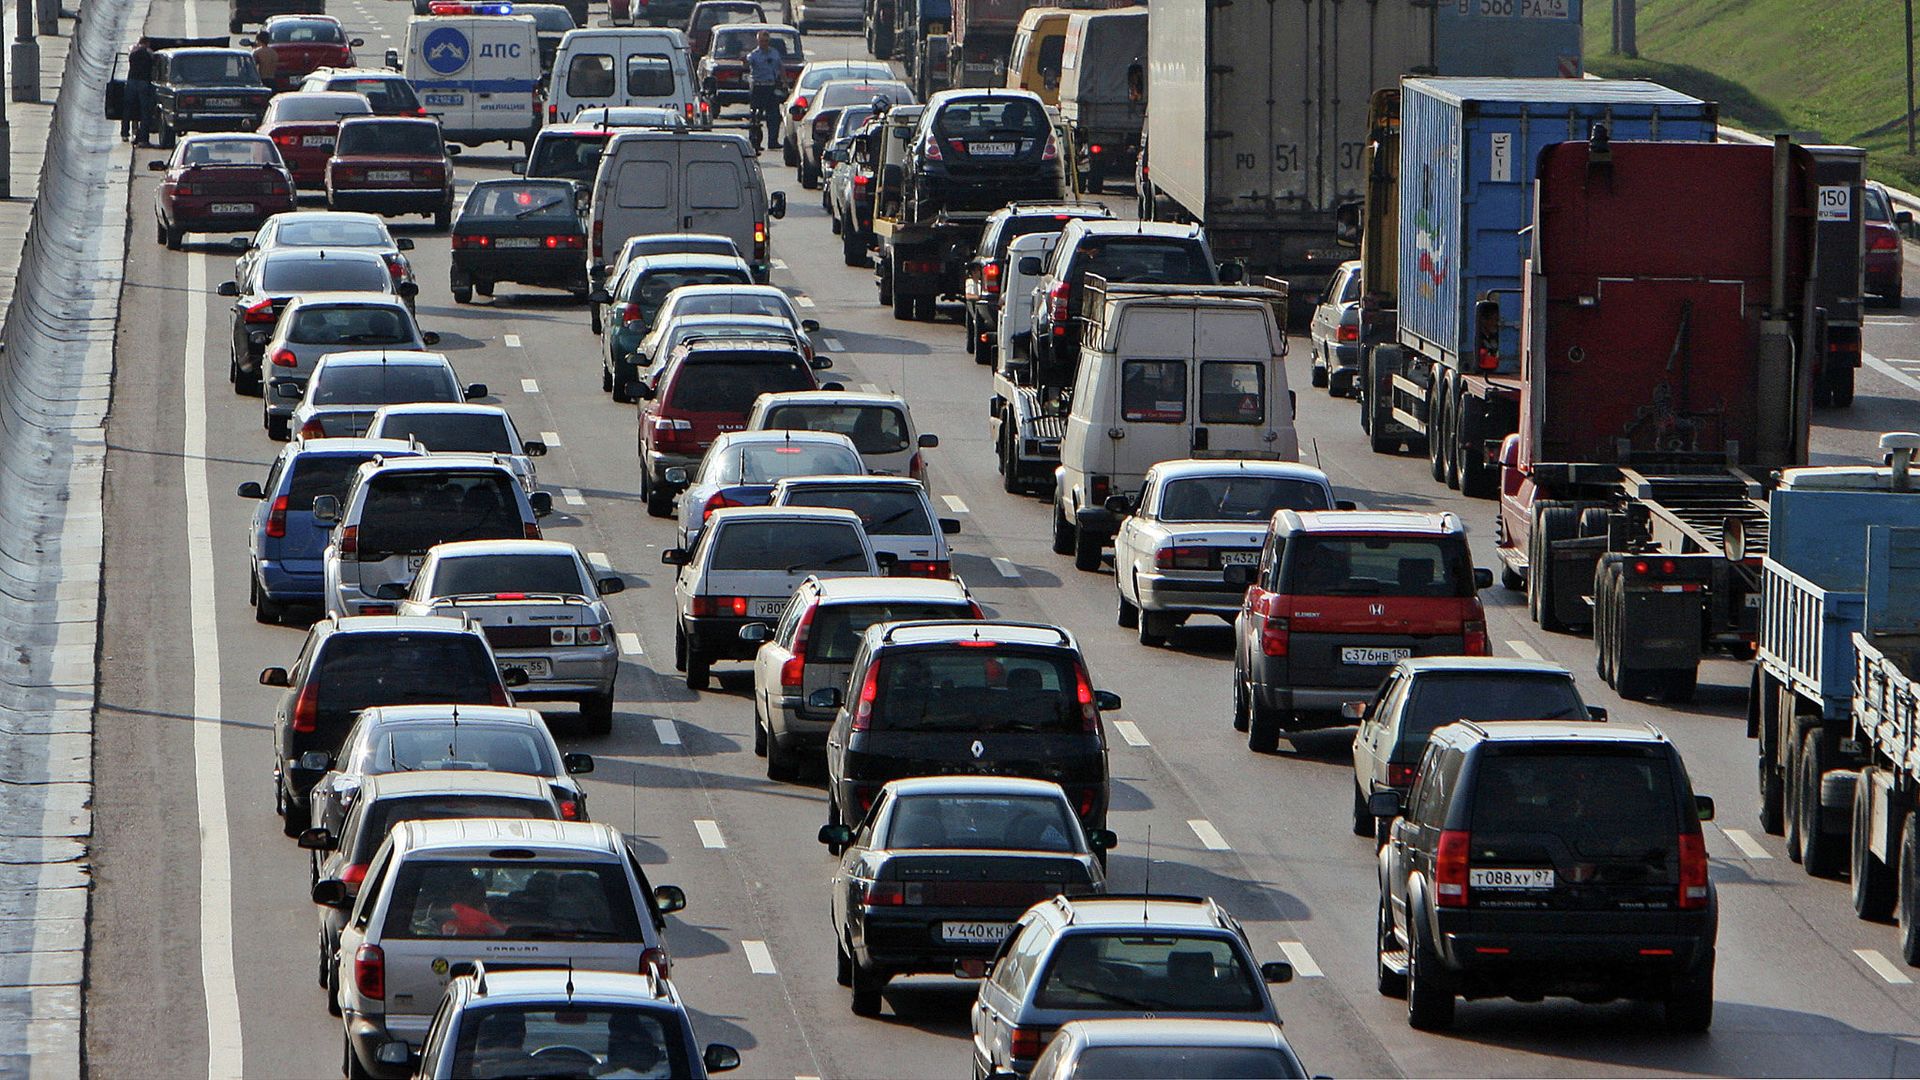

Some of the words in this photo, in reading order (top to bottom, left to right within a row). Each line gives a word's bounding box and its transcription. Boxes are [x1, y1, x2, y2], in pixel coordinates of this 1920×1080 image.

[480, 43, 521, 58] ДПС
[1276, 144, 1298, 172] 51
[1341, 142, 1366, 170] 37
[1820, 190, 1847, 206] 150
[1040, 237, 1049, 249] 7
[1344, 649, 1389, 661] С376НВ
[1391, 649, 1408, 659] 150
[530, 661, 542, 671] 55
[1476, 871, 1531, 885] Т088ХУ
[1535, 871, 1549, 882] 97
[948, 924, 1004, 938] У440КН
